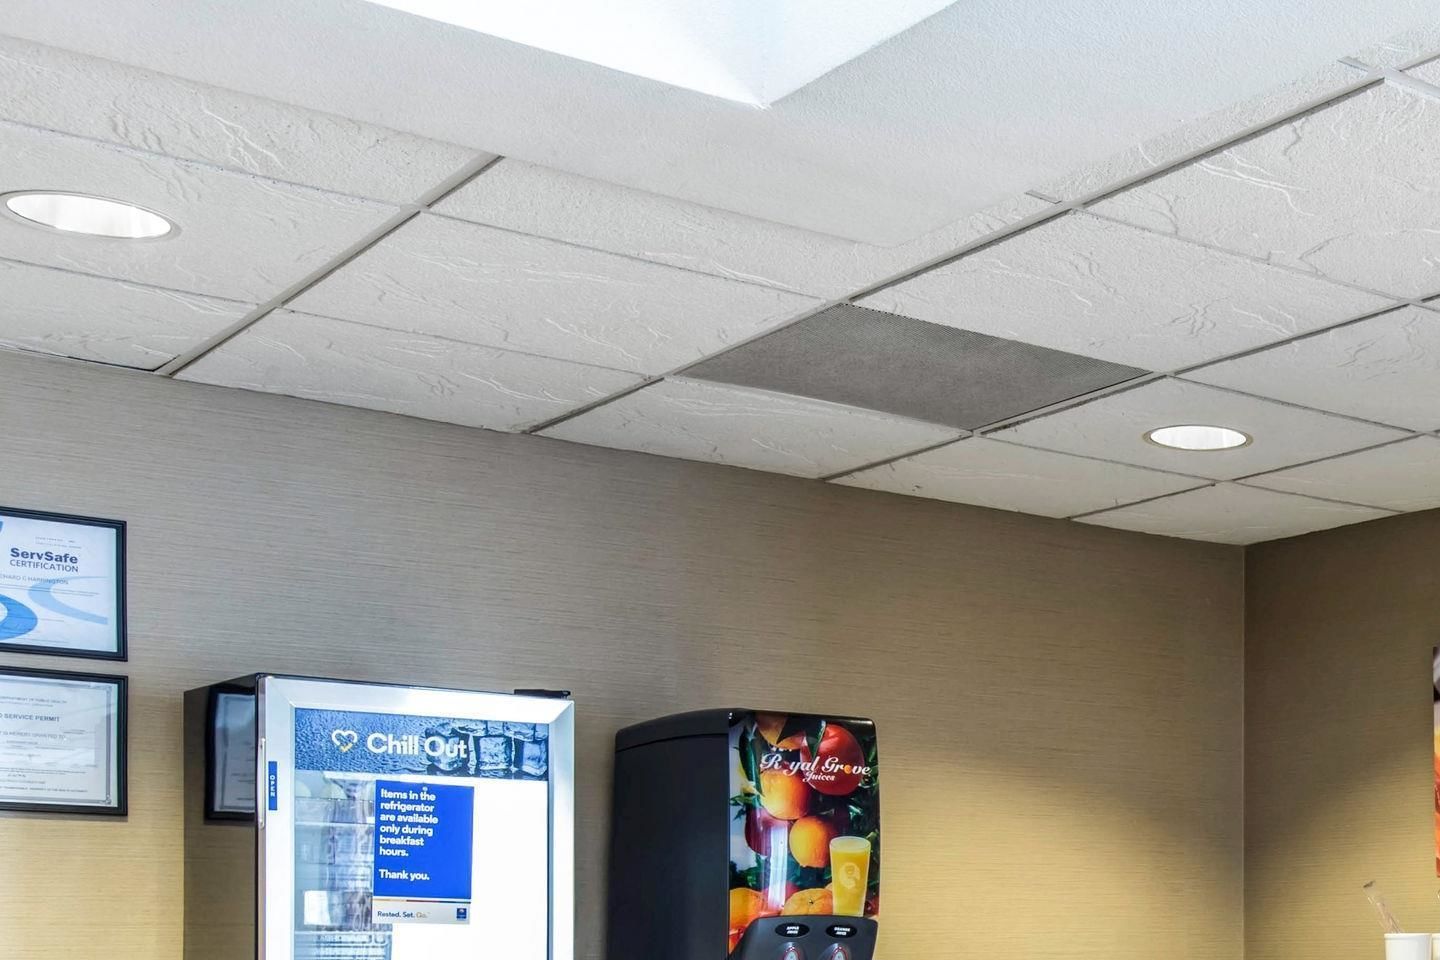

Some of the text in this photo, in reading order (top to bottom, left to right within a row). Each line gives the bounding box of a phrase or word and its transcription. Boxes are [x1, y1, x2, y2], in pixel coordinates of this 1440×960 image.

[10, 547, 79, 564] ServSafe
[9, 560, 79, 573] CERTIFICATION
[4, 713, 34, 721] SERVICE
[366, 733, 468, 758] Chill Out
[821, 756, 871, 775] Grove
[381, 788, 436, 801] Items in the
[380, 801, 435, 812] refrigerator
[380, 813, 438, 824] are available
[380, 824, 433, 837] only during
[380, 835, 424, 846] breakfast
[379, 846, 409, 857] hours.
[379, 868, 430, 881] Thank you.
